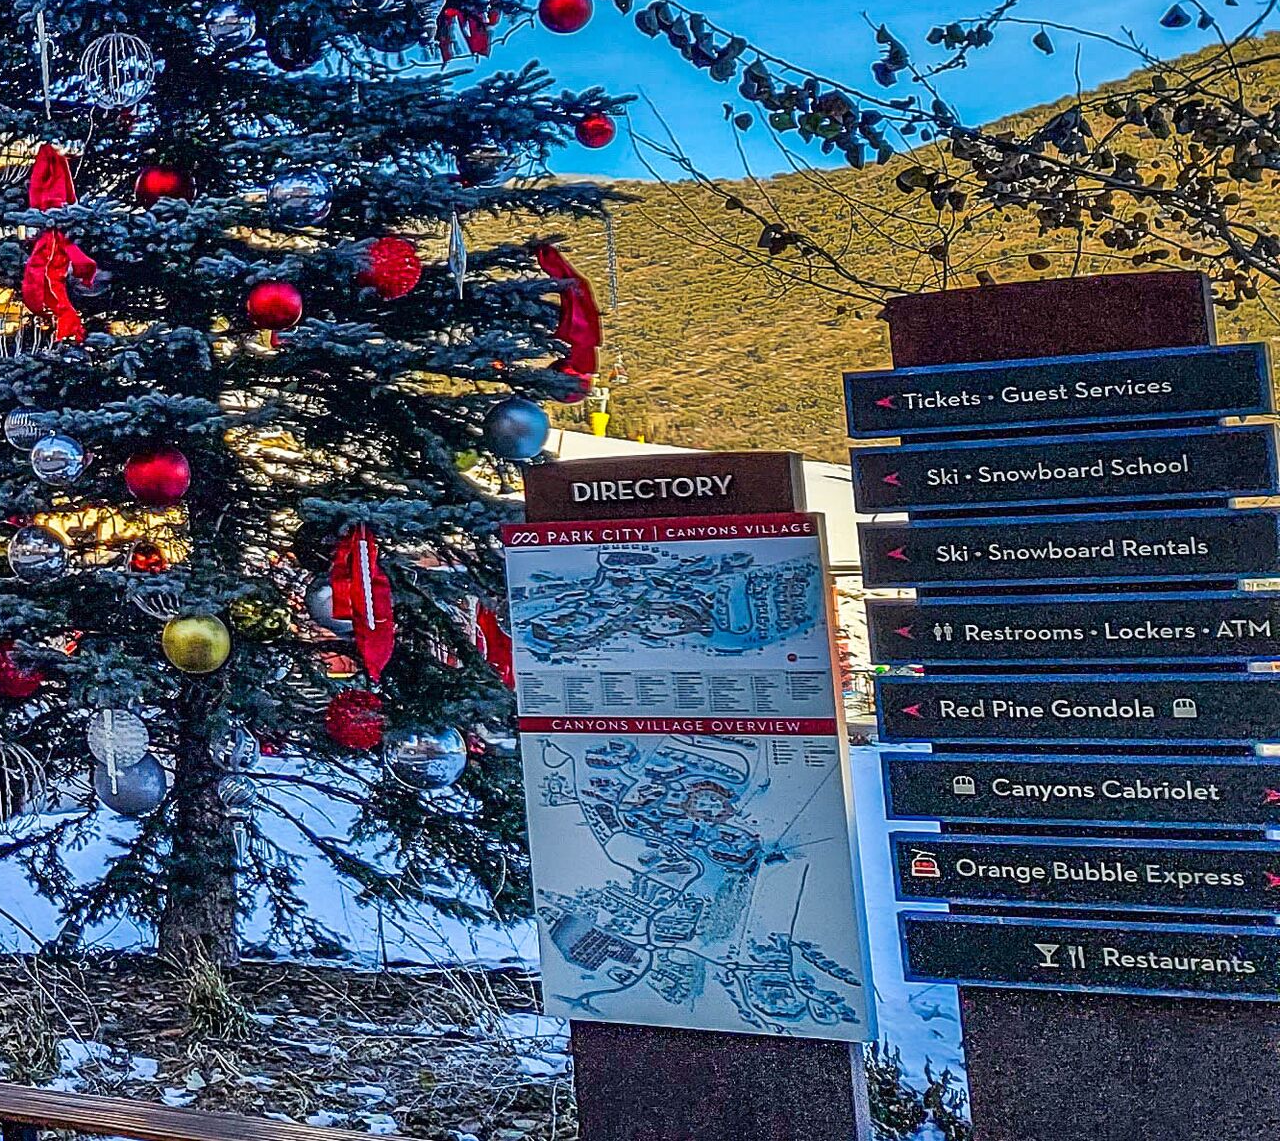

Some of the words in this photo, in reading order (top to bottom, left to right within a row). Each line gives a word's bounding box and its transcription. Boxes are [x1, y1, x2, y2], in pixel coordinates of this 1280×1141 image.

[903, 390, 981, 411] Tickets
[1001, 383, 1068, 405] Guest
[1075, 378, 1172, 400] Services
[926, 467, 960, 487] Ski
[978, 459, 1104, 484] Snowboard
[1111, 454, 1189, 477] School
[572, 474, 734, 503] DIRECTORY
[547, 529, 594, 543] PARK
[602, 527, 645, 541] CITY
[665, 525, 740, 538] CANYONS
[744, 522, 812, 535] VILLAGE
[936, 544, 968, 563] Ski
[989, 538, 1115, 562] Snowboard
[1122, 536, 1209, 558] Rentals
[965, 623, 1084, 642] Restrooms
[1104, 621, 1196, 641] Lockers
[1216, 619, 1272, 639] ATM
[940, 699, 985, 719] Red
[992, 699, 1044, 719] Pine
[1051, 698, 1155, 719] Gondola
[551, 719, 629, 731] CANYONS
[635, 720, 706, 731] VILLAGE
[711, 720, 801, 732] OVERVIEW
[992, 778, 1095, 803] Canyons
[1102, 780, 1220, 801] Cabriolet
[956, 858, 1046, 884] Orange
[1053, 862, 1138, 883] Bubble
[1147, 865, 1245, 890] Express
[1103, 947, 1256, 975] Restaurants
